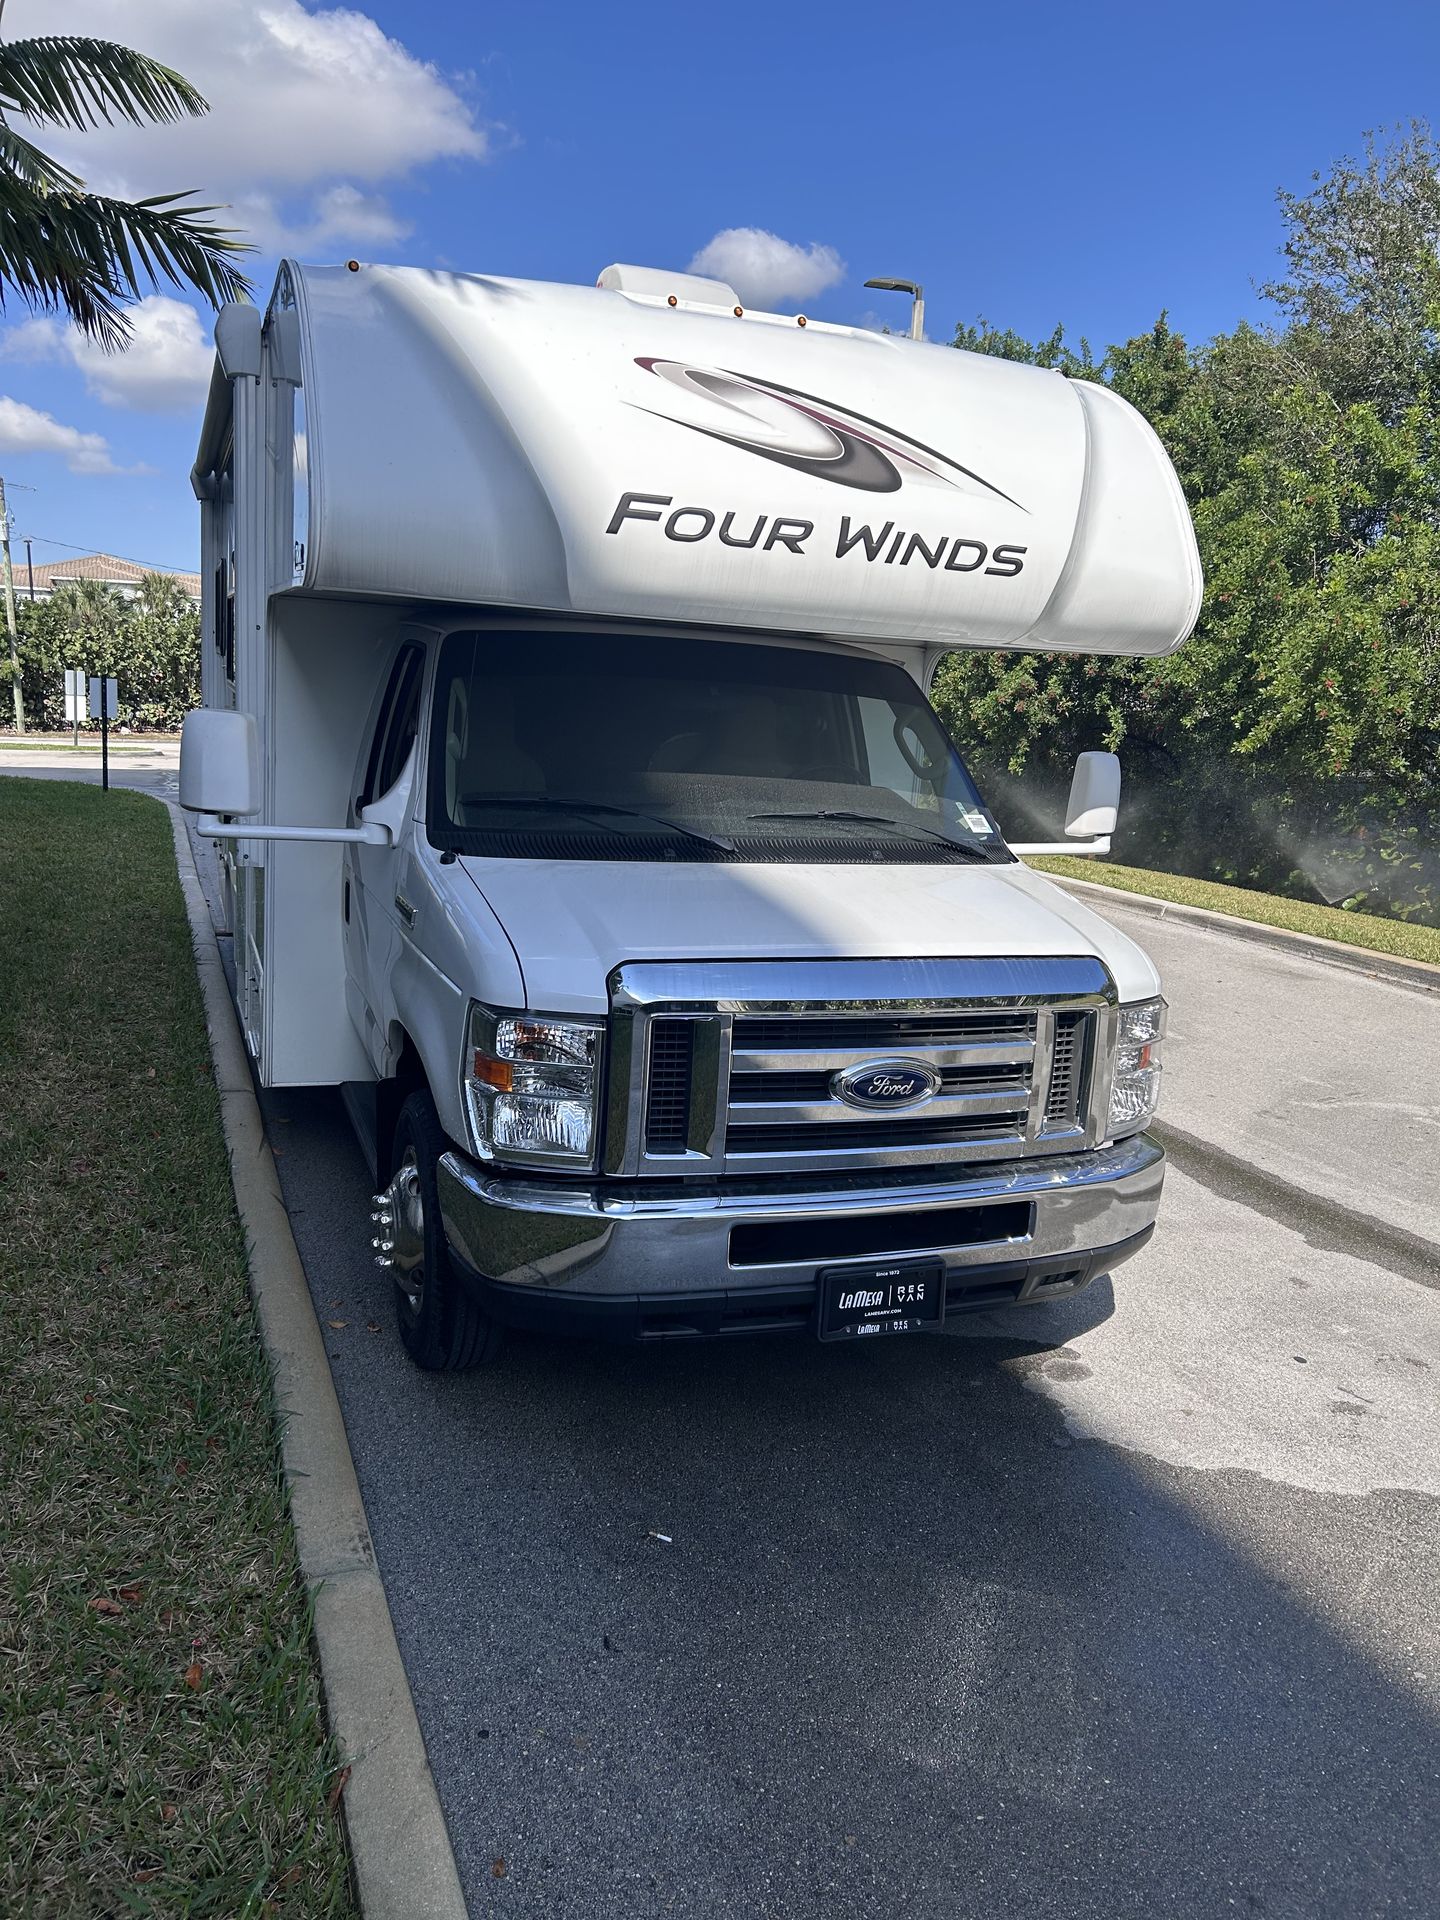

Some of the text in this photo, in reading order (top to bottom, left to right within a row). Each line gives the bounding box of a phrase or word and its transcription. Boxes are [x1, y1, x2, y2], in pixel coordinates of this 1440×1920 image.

[605, 492, 1028, 578] FOUR WINDS
[868, 1074, 914, 1096] Ford
[898, 1284, 925, 1294] REC
[898, 1292, 924, 1302] VAN
[864, 1309, 902, 1317] LAMESARV.COM
